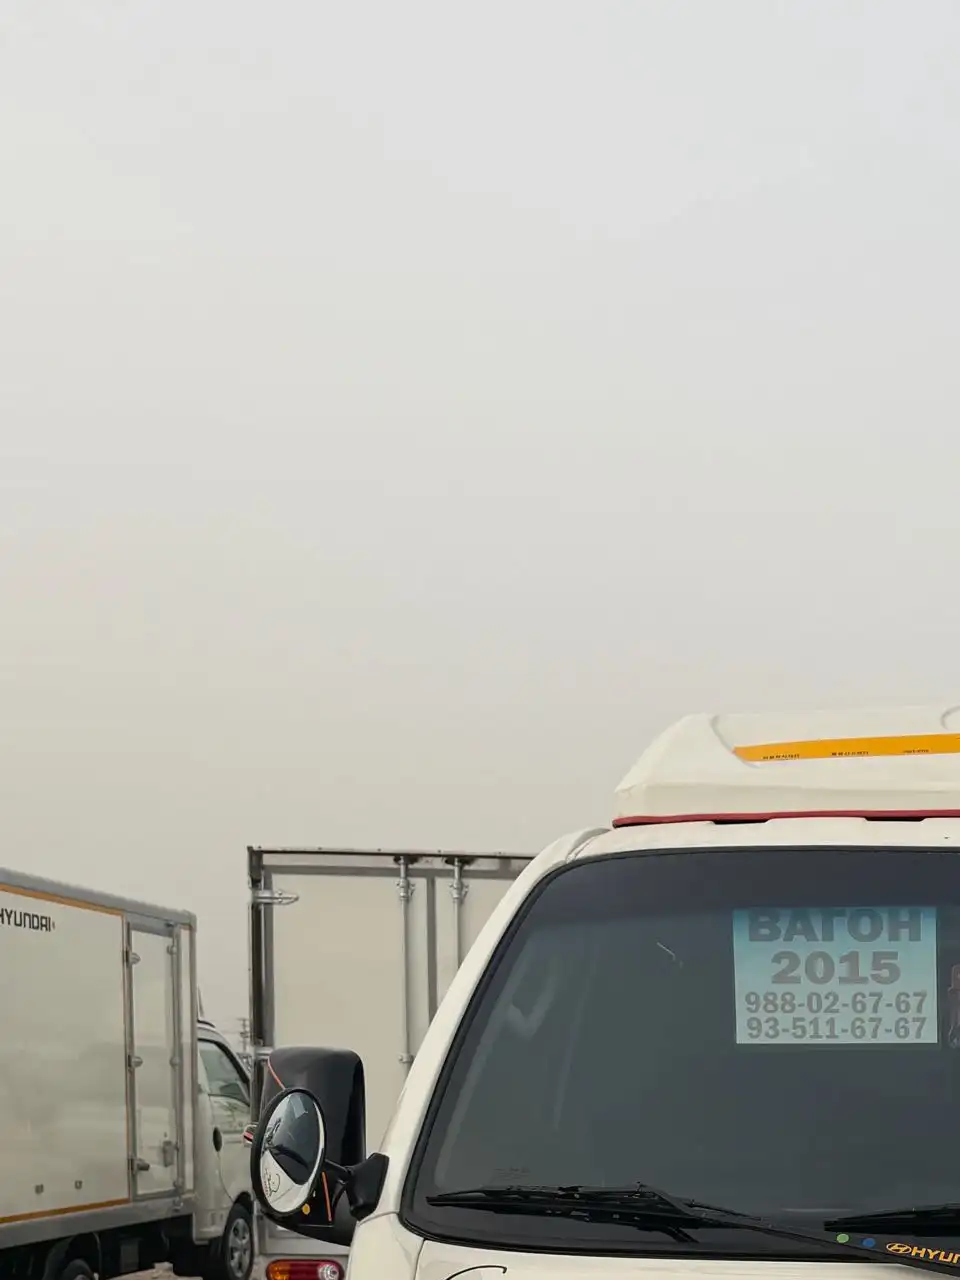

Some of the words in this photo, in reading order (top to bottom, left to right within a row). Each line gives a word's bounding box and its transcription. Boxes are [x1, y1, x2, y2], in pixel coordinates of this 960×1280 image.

[748, 908, 922, 943] ВАГОН
[771, 950, 902, 985] 2015
[745, 991, 928, 1014] 988-02-67-67
[746, 1016, 927, 1039] 93-511-67-67
